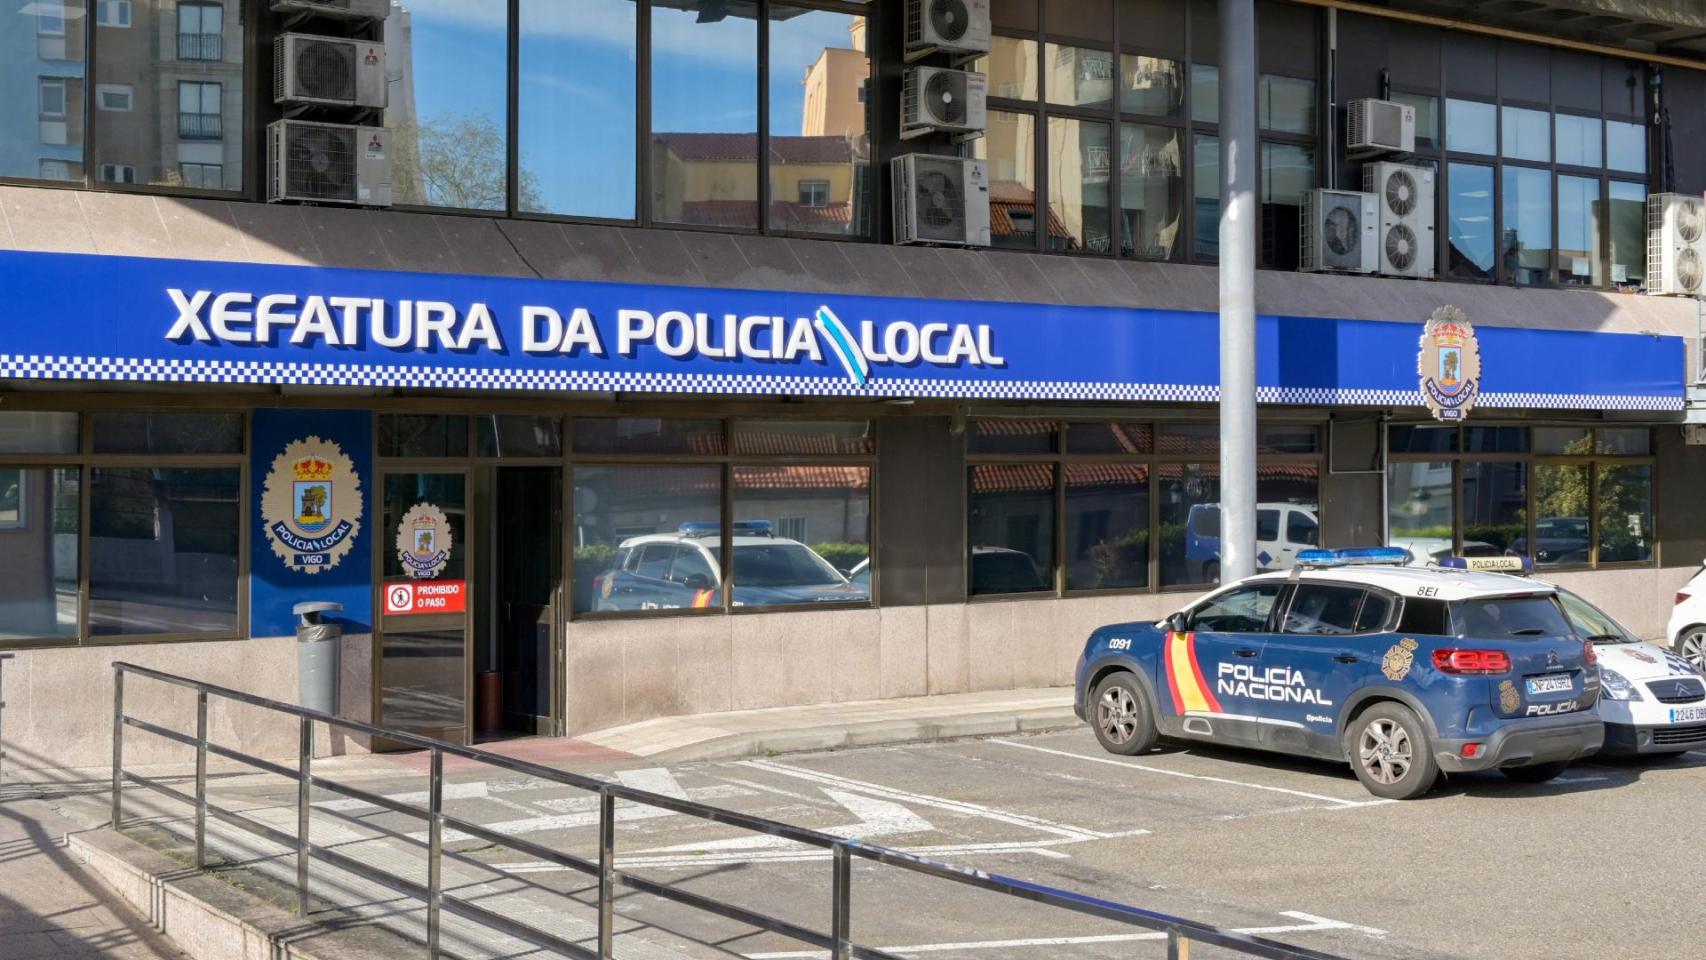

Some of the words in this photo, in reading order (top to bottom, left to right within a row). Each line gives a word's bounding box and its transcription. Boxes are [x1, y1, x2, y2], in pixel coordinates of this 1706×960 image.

[165, 288, 502, 350] XEFATURA
[521, 305, 602, 354] DA
[617, 308, 822, 361] POLICIA
[861, 320, 1004, 365] LOCAL
[1427, 381, 1452, 408] POLICIA
[1454, 383, 1473, 405] LOCAL
[276, 525, 314, 551] POLICIA
[320, 523, 350, 549] LOCAL
[302, 555, 323, 564] VIGO
[403, 552, 425, 570] POLICIA
[427, 553, 446, 568] LOCAL
[1472, 560, 1496, 569] POLICIA
[1497, 560, 1516, 568] LOCAL
[417, 585, 459, 595] PROHIBIDO
[417, 599, 424, 607] O
[425, 598, 446, 608] PASO
[1218, 662, 1306, 687] POLICÍA
[1218, 679, 1333, 705] NACIONAL
[1526, 699, 1577, 716] POLICÍA
